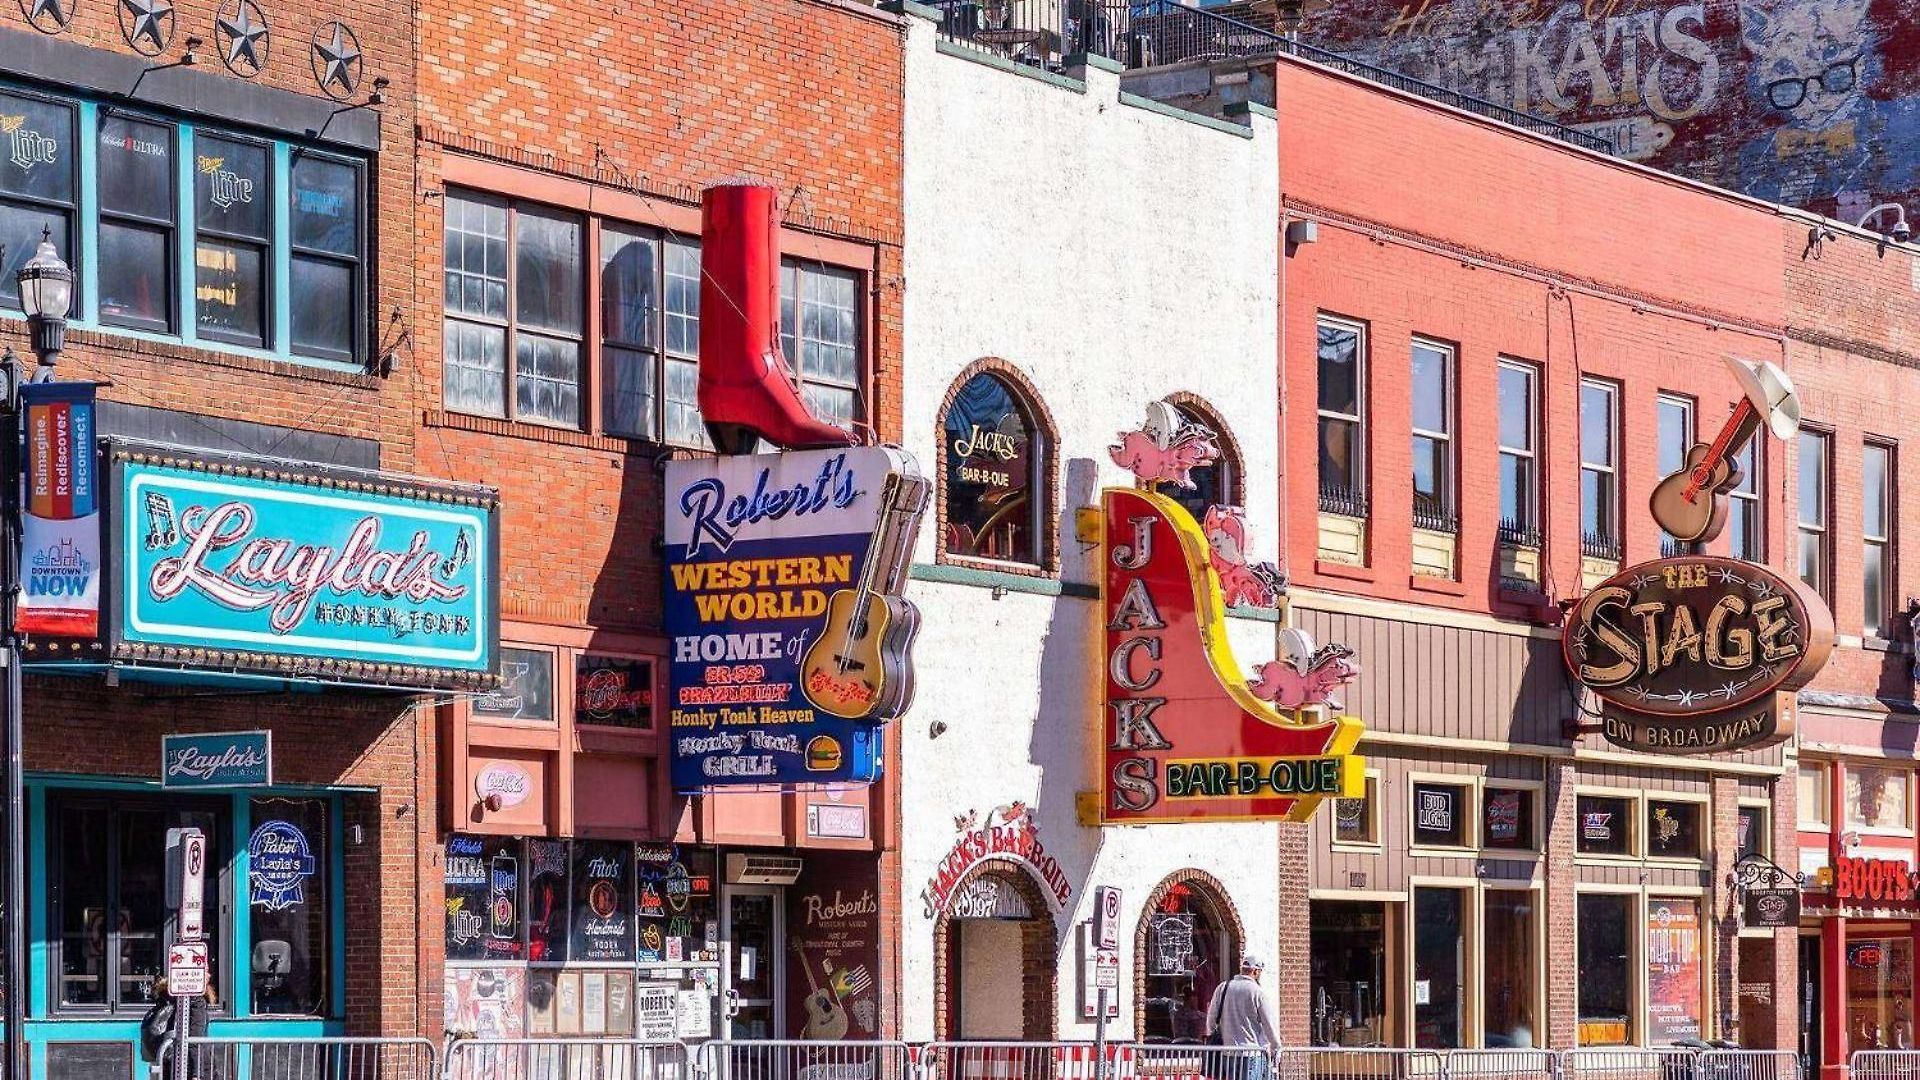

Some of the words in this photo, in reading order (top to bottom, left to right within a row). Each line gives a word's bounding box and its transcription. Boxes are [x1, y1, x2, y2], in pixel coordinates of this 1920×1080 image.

[10, 130, 57, 173] Lite
[133, 140, 166, 156] ULTRA
[210, 169, 252, 208] Lite
[35, 415, 47, 496] Reimagine.
[56, 410, 68, 496] Rediscover.
[76, 412, 89, 496] Reconnect.
[955, 424, 1018, 460] JACK'S
[962, 467, 1009, 486] BAR-B-QUE
[680, 453, 867, 560] Robert's
[31, 567, 81, 575] DOWNTOWN
[150, 500, 466, 635] Layla's
[671, 555, 853, 591] WESTERN
[1662, 564, 1709, 589] THE
[29, 575, 89, 596] NOW
[408, 610, 471, 636] TONK
[695, 590, 827, 622] WORLD
[674, 632, 783, 663] HOME
[786, 627, 810, 665] of
[1580, 585, 1800, 687] STAGE
[1106, 516, 1172, 810] JACKS
[671, 708, 718, 730] Honky
[719, 706, 757, 725] Tonk
[759, 706, 815, 724] Heaven
[1606, 718, 1634, 742] ON
[1646, 712, 1769, 747] BROADWAY
[169, 746, 265, 780] Layla's
[703, 755, 777, 777] GRILL
[1166, 757, 1342, 797] BAR-B-QUE
[1420, 810, 1450, 826] LIGHT
[1424, 795, 1445, 810] BUD
[262, 832, 299, 854] Pabst
[261, 857, 301, 870] Layla's
[588, 857, 619, 878] Tito's
[920, 830, 987, 920] JACK'S
[1836, 856, 1909, 901] BOOTS
[803, 890, 877, 925] Robert's
[453, 909, 482, 945] Lite
[1662, 964, 1681, 974] BAR
[640, 996, 675, 1010] ROBERT'S
